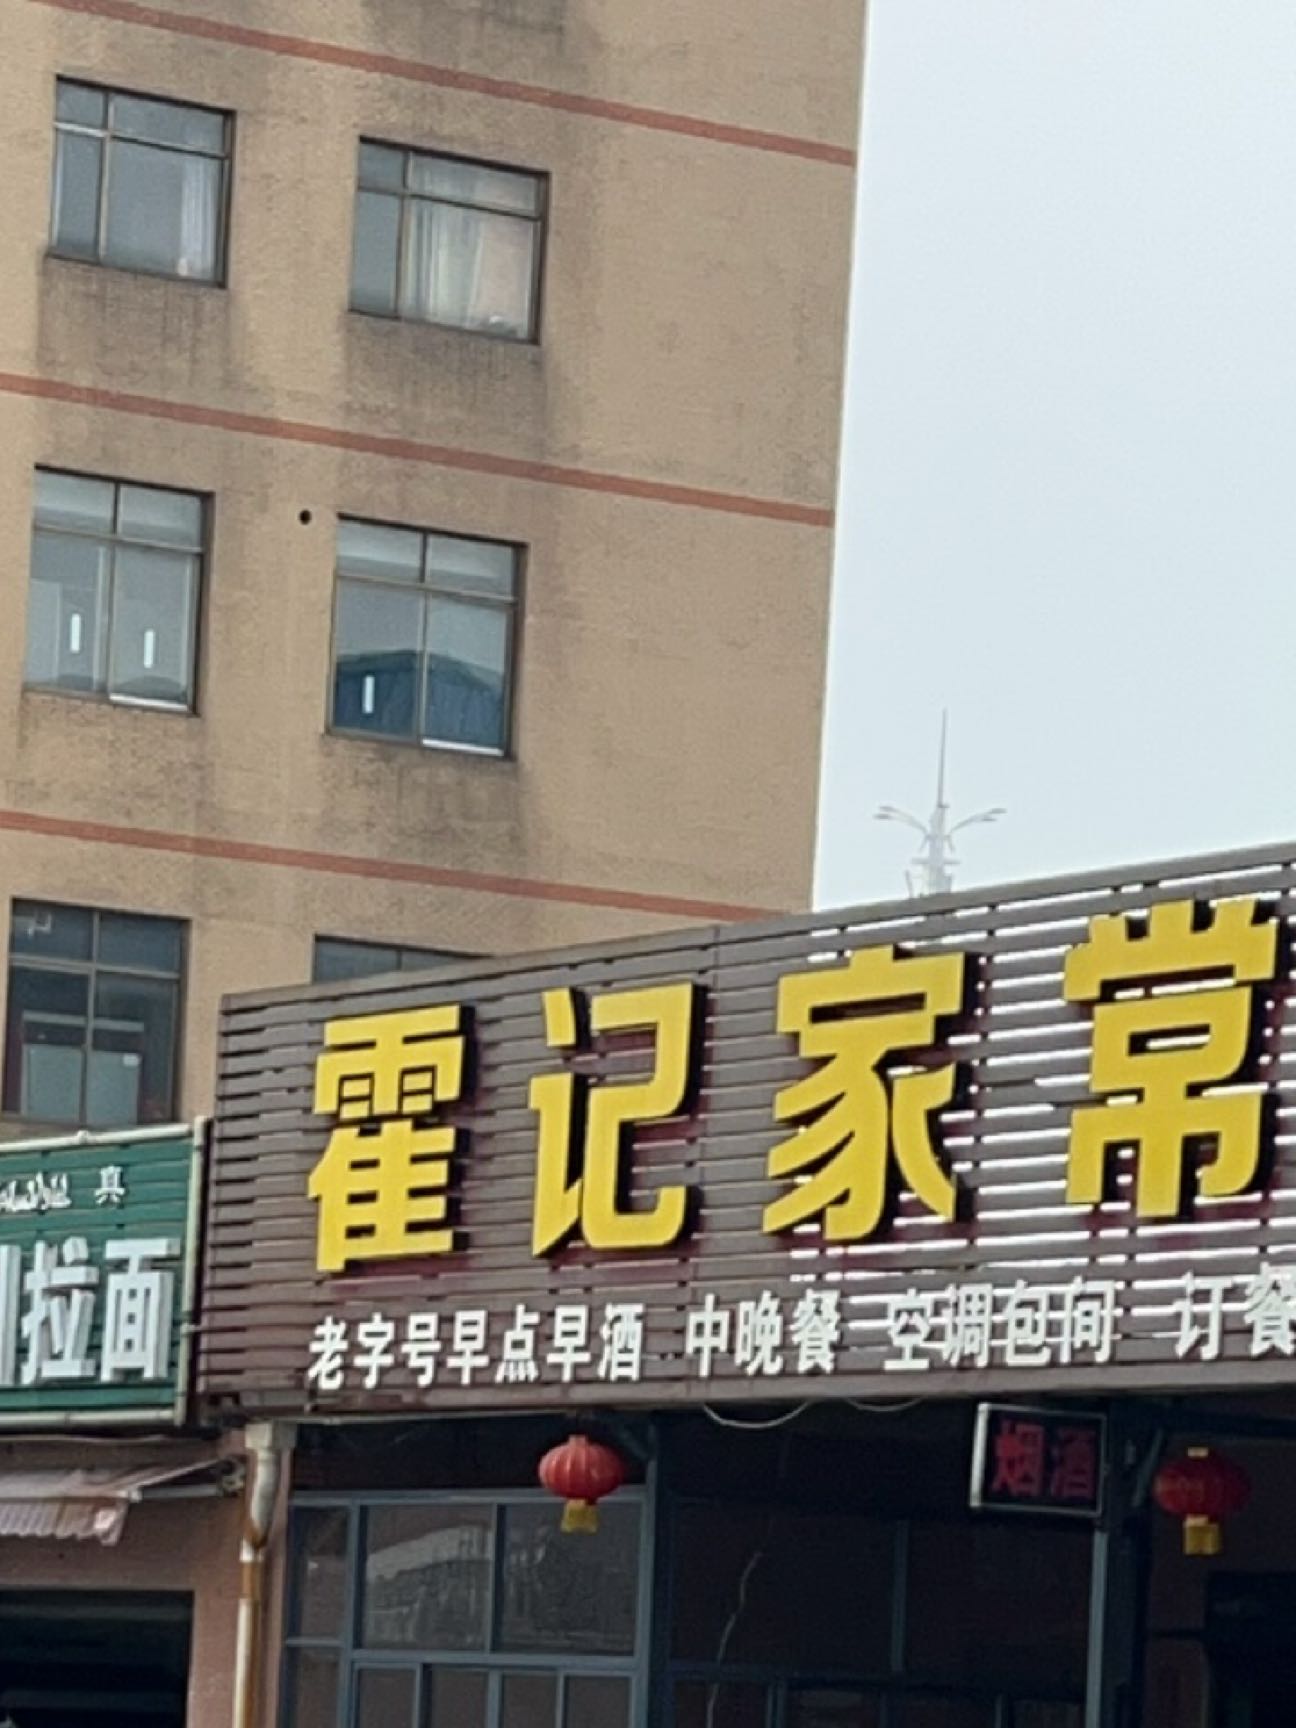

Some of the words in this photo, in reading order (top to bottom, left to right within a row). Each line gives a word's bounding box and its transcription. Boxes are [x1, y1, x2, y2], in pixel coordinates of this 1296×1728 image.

[307, 897, 1281, 1275] 霍记家常
[307, 1303, 645, 1391] 老字号早点早酒
[685, 1289, 842, 1377] 中晚餐
[883, 1276, 1115, 1370] 空调包间
